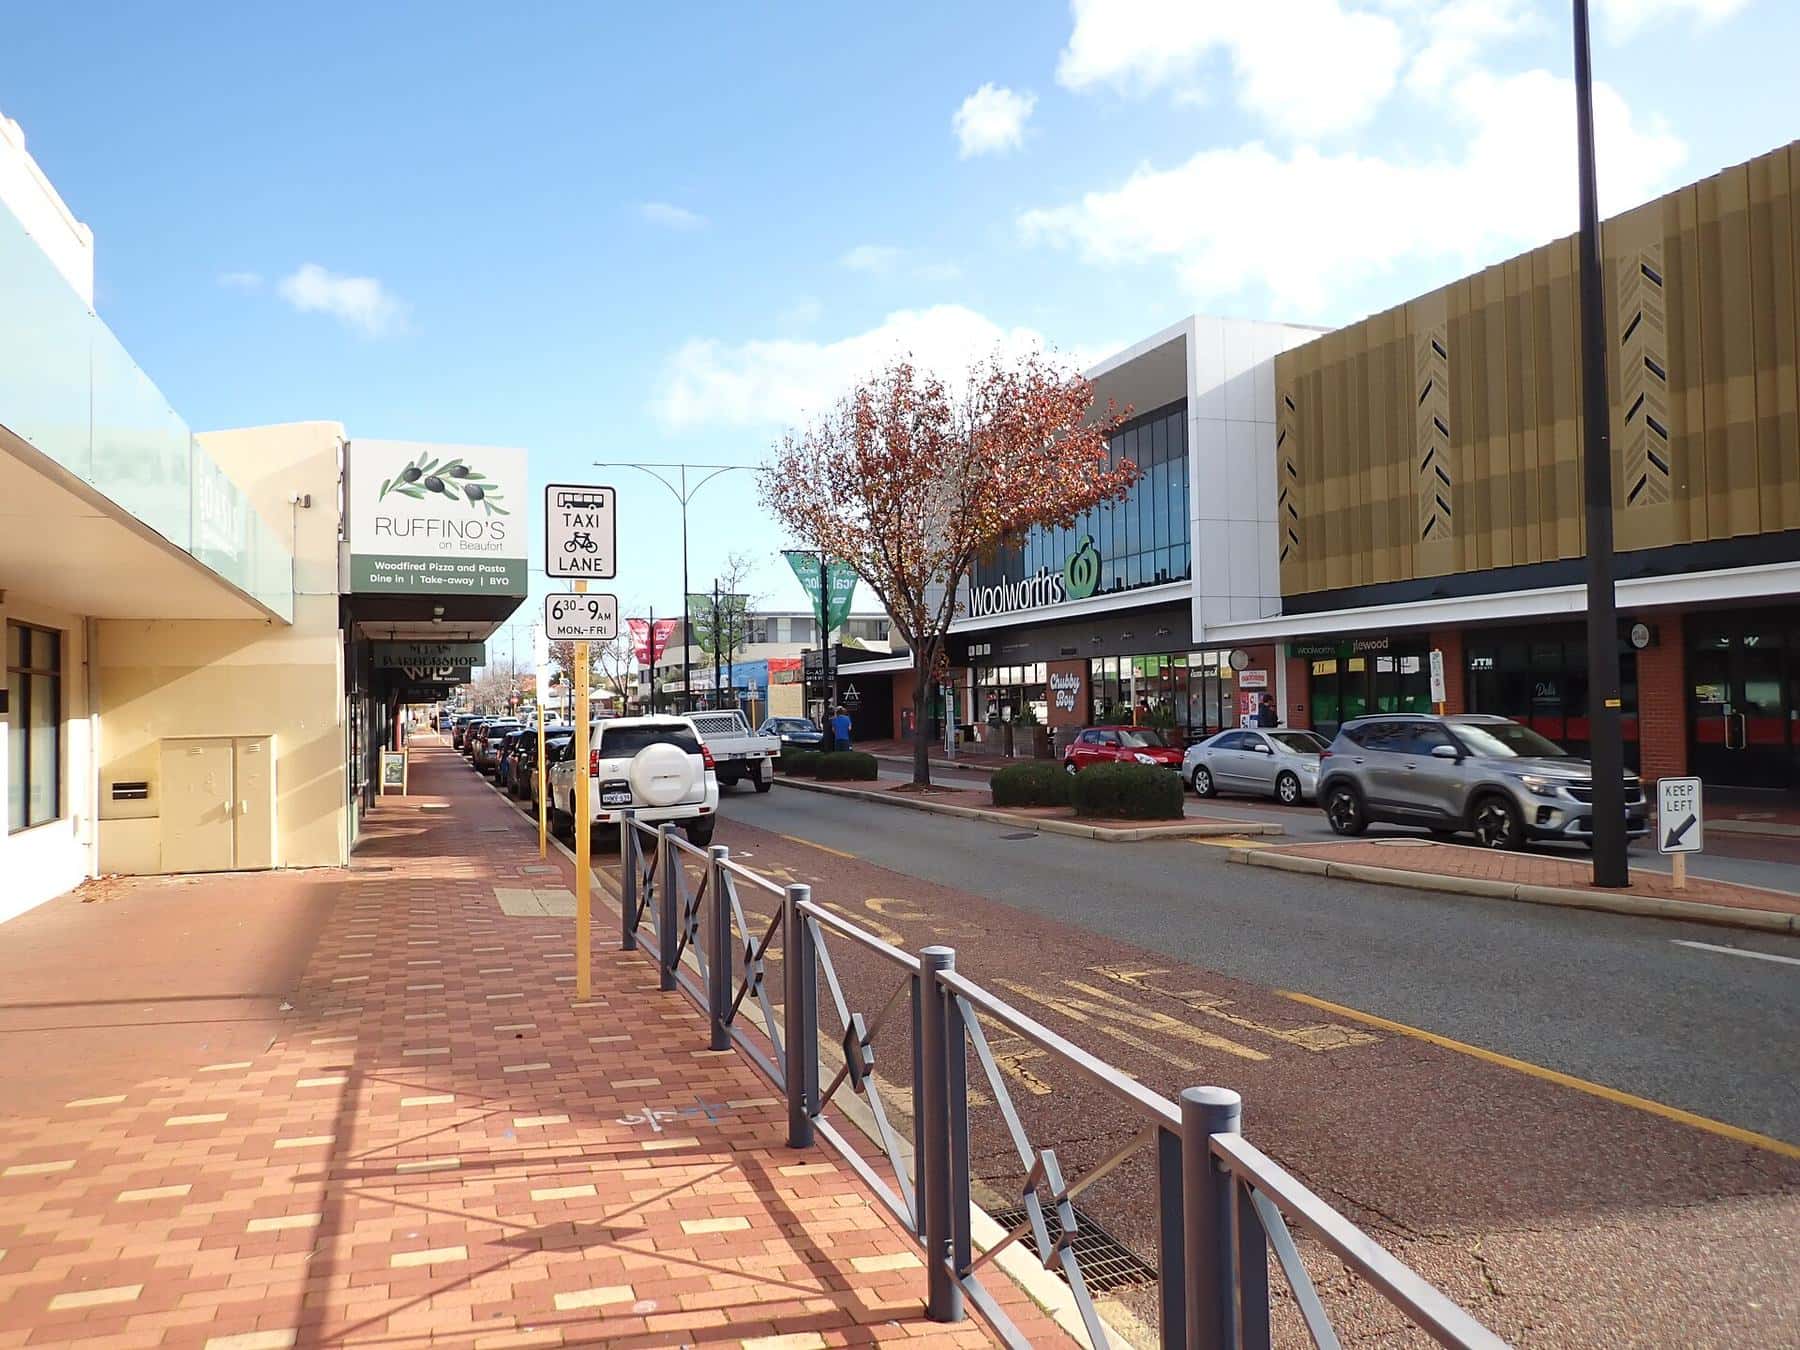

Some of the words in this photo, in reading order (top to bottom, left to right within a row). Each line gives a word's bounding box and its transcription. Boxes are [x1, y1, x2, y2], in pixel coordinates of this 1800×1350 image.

[563, 513, 599, 528] TAXI
[375, 517, 506, 540] RUFFINO'S
[439, 541, 453, 550] on
[459, 540, 503, 551] Beaufort
[375, 561, 426, 571] Woodfired
[429, 563, 454, 572] Pizza
[457, 564, 475, 573] and
[478, 564, 506, 573] Pasta
[560, 557, 603, 572] LANE
[370, 574, 392, 583] Dine
[395, 574, 404, 583] in
[420, 575, 474, 586] Take-away
[490, 577, 509, 585] BYO
[1050, 672, 1080, 694] Chubby
[1056, 690, 1074, 712] Boy
[1665, 785, 1694, 796] KEEP
[1666, 800, 1692, 811] LEFT
